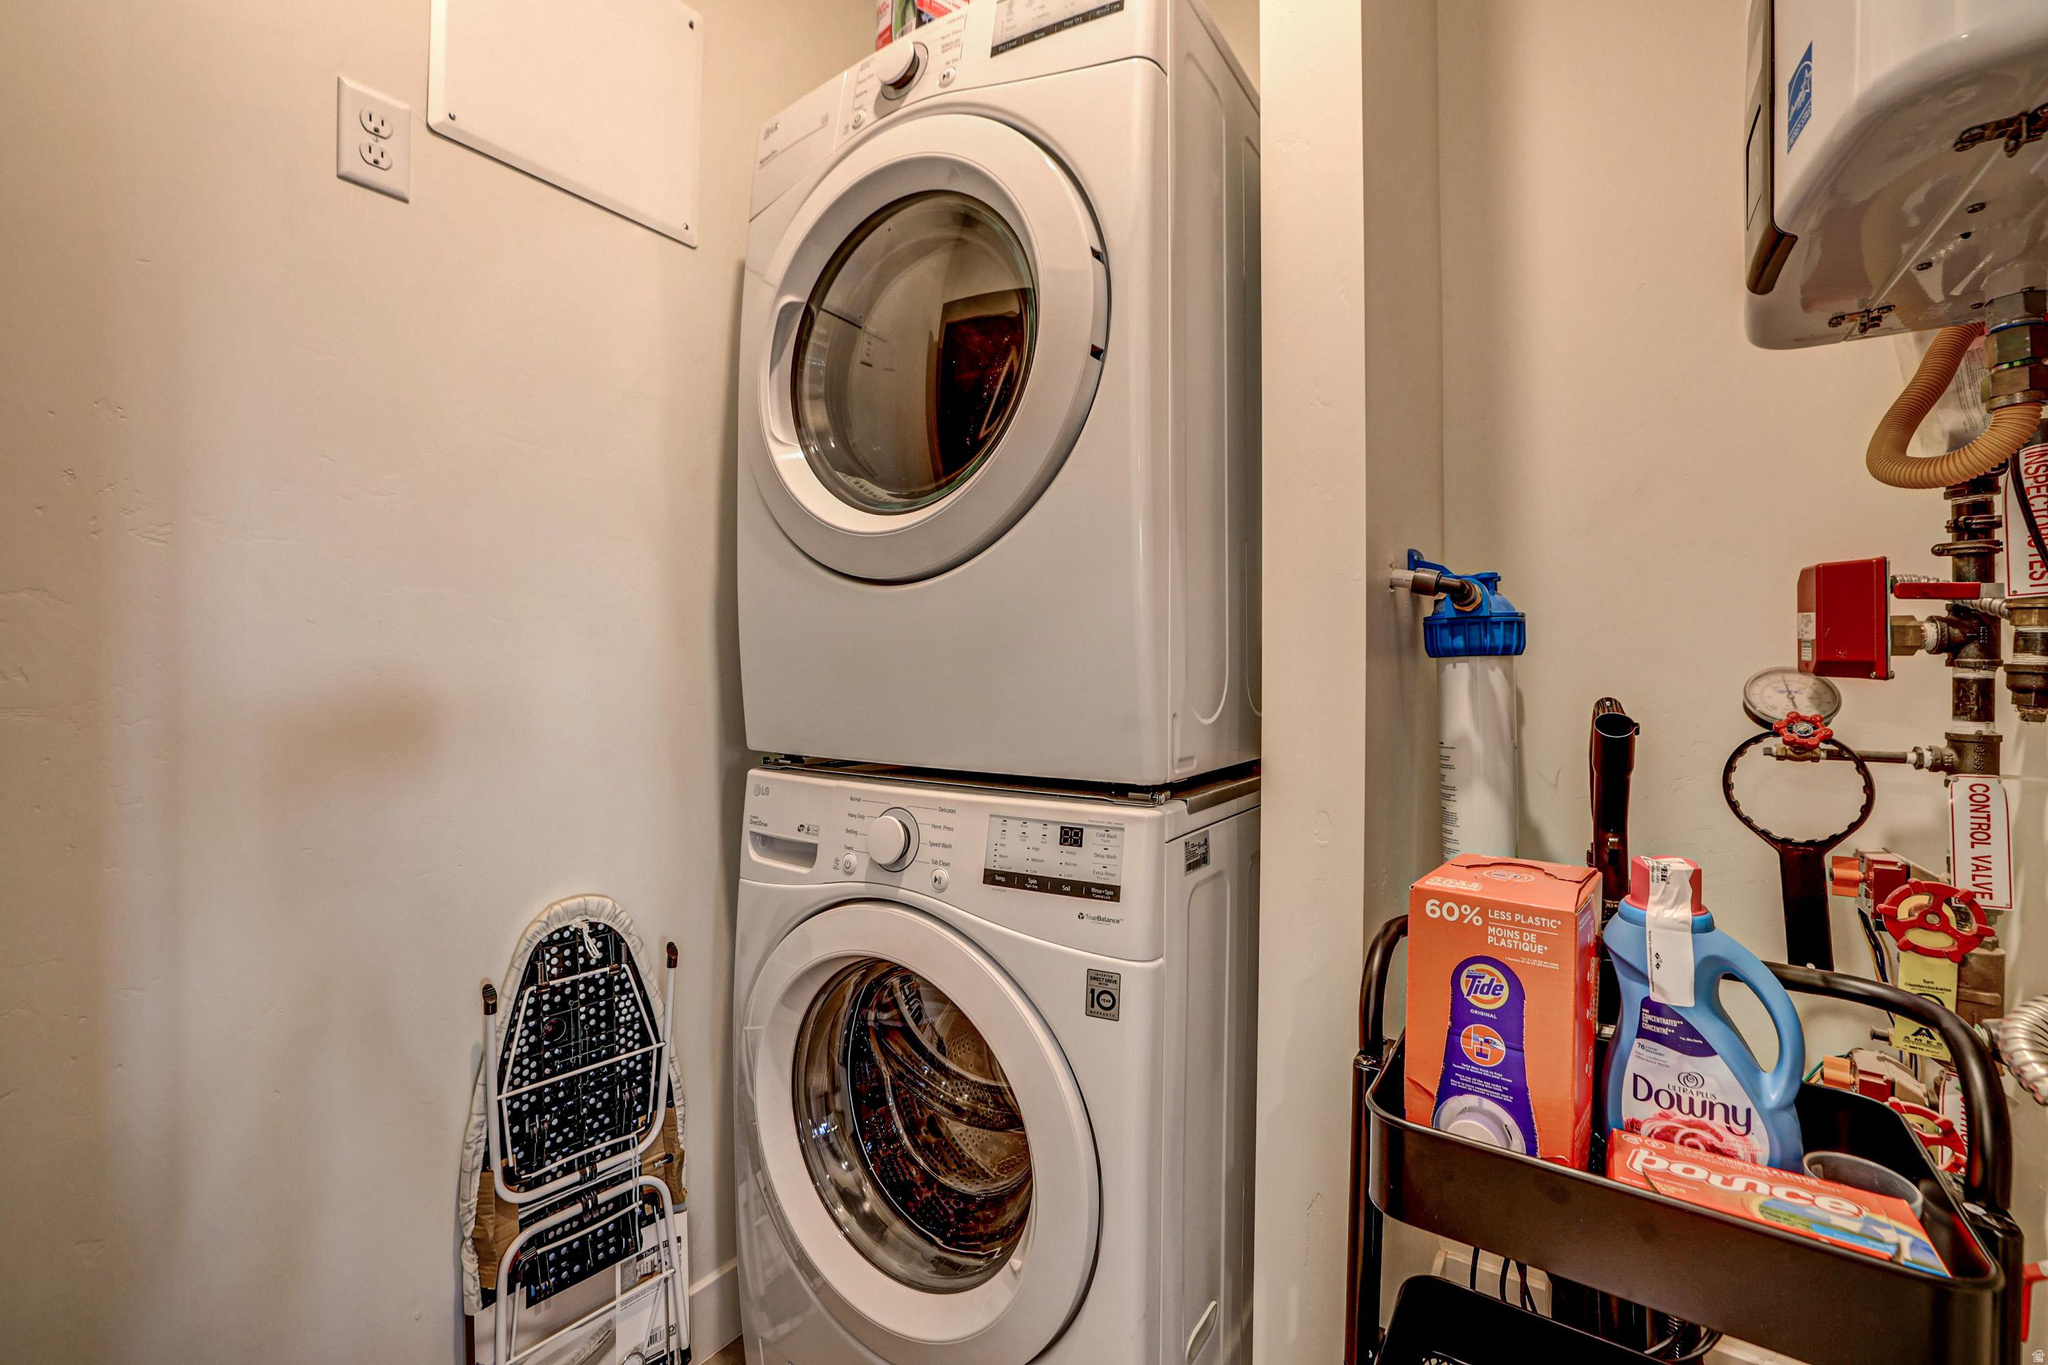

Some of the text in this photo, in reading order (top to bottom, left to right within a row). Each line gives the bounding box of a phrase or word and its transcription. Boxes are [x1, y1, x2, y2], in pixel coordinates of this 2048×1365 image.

[938, 806, 956, 814] Delicates
[1968, 783, 1992, 849] CONTROL
[929, 841, 941, 849] Speed
[1971, 854, 1994, 901] VALVE
[1091, 887, 1114, 896] Rinse+Spin
[1425, 898, 1483, 926] 60%
[1488, 908, 1512, 922] LESS
[1488, 926, 1536, 942] MOINS DE
[1465, 974, 1504, 998] Tide
[1904, 982, 1952, 992] Counterclockwise
[1090, 988, 1116, 1011] 10
[1470, 1008, 1497, 1019] ORIGINAL
[1637, 1042, 1646, 1050] 76
[1668, 1084, 1718, 1100] ULTRA PLUS
[1632, 1073, 1752, 1136] Downy
[1627, 1148, 1864, 1218] bounce
